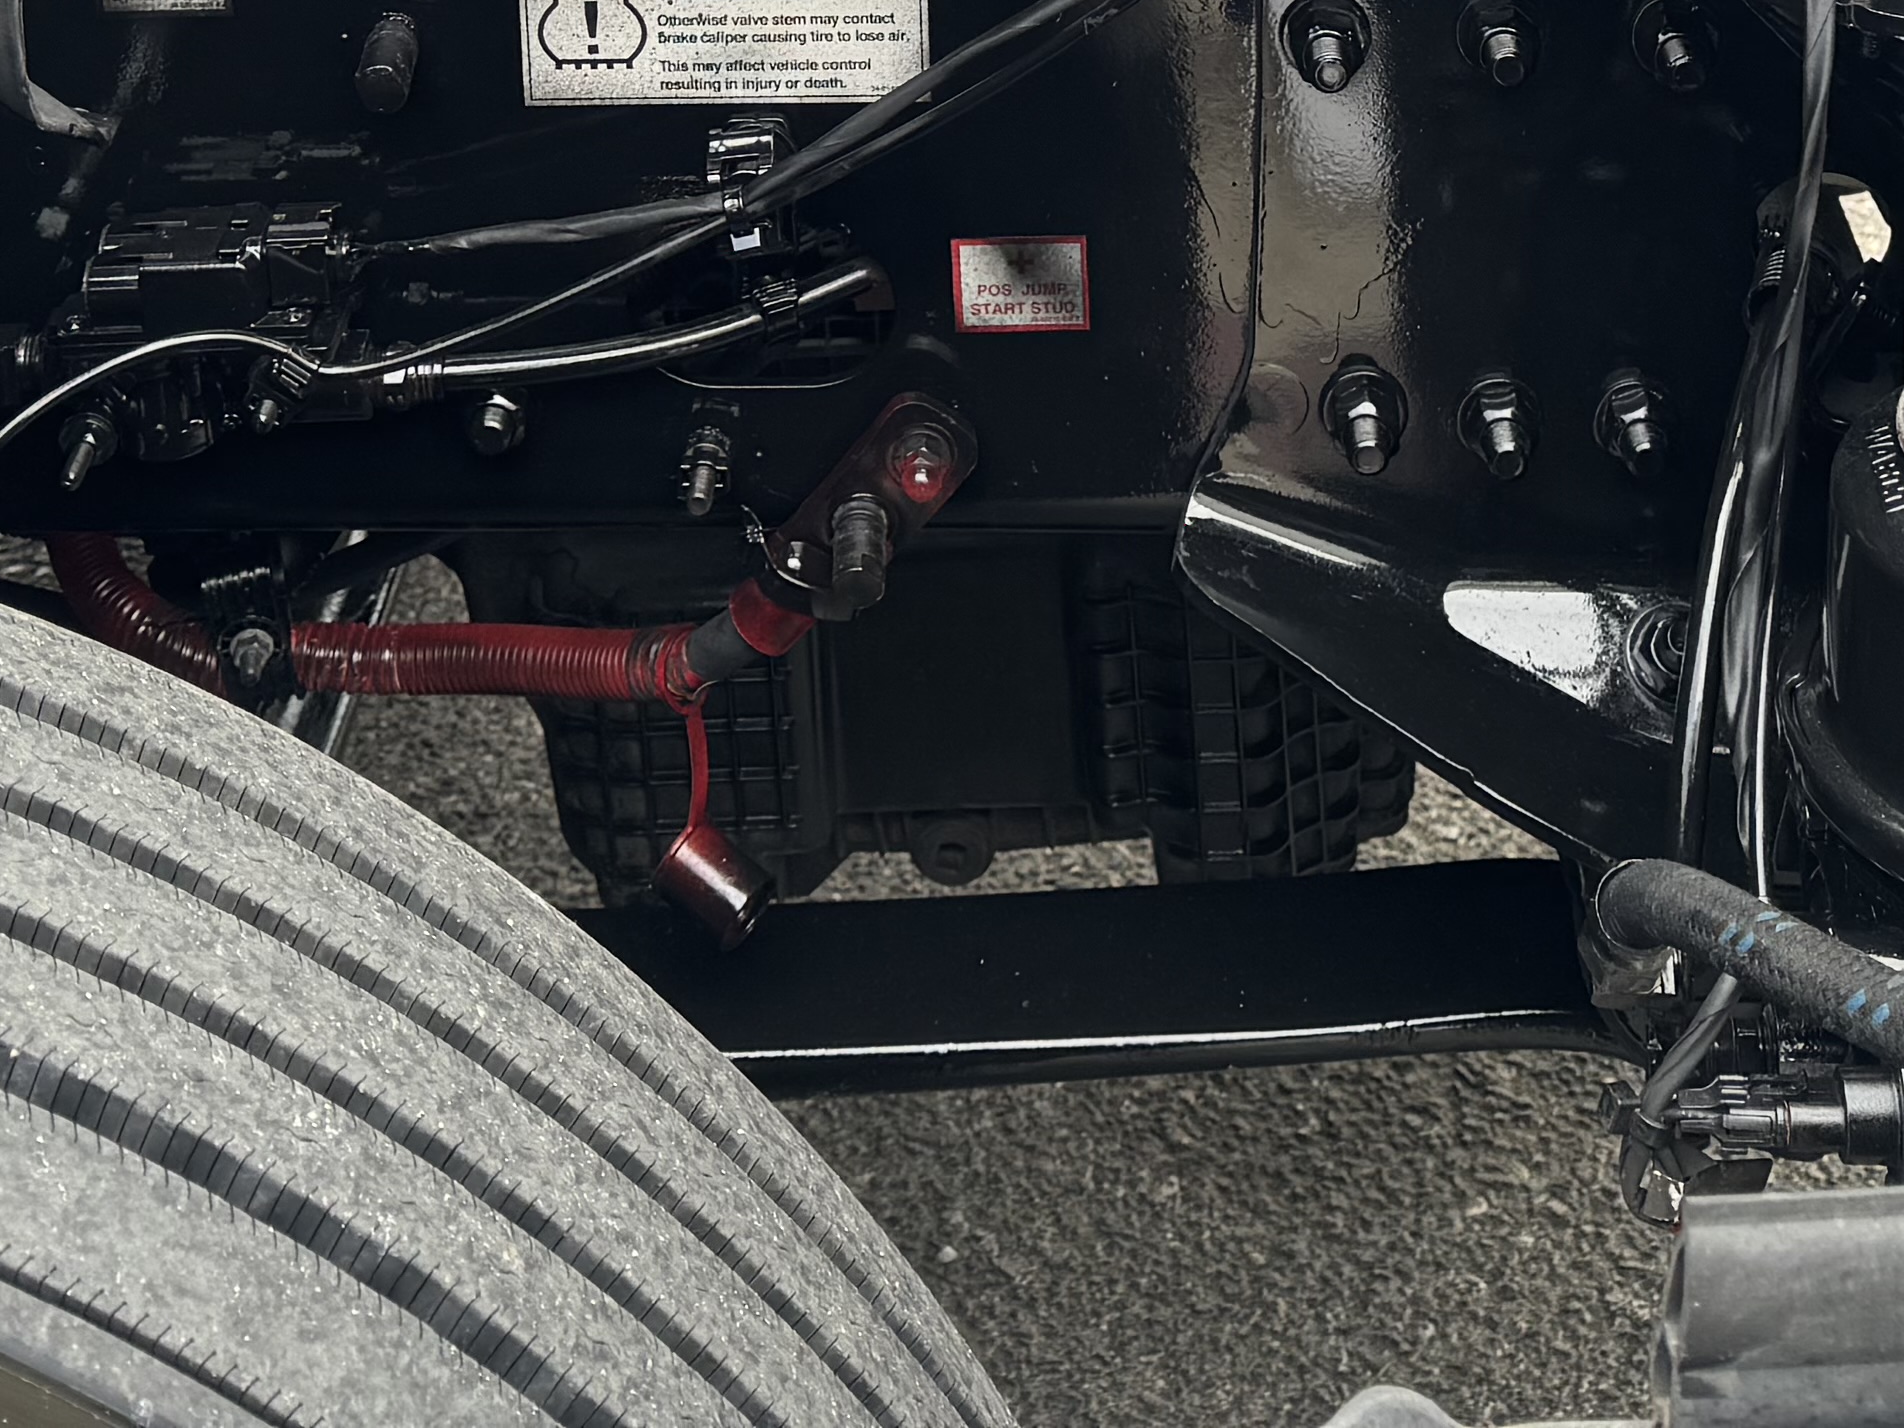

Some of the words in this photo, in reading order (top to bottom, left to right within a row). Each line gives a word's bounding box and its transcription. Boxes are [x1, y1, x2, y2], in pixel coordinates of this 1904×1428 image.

[657, 13, 729, 28] Otherwise
[731, 13, 769, 27] valve
[771, 14, 807, 27] stem
[809, 14, 839, 29] may
[842, 12, 896, 26] contact
[657, 30, 698, 44] brake
[699, 30, 748, 47] caliper
[751, 30, 807, 46] causing
[809, 29, 834, 43] tire
[836, 30, 852, 43] to
[855, 28, 885, 42] lose
[658, 59, 689, 73] This
[692, 61, 723, 75] may
[725, 59, 766, 73] affect
[768, 58, 819, 72] vehicle
[821, 57, 872, 72] control
[659, 75, 722, 93] resulting
[724, 76, 739, 90] in
[742, 76, 782, 93] injury
[784, 78, 802, 90] or
[803, 76, 848, 90] death.
[977, 283, 1014, 298] POS
[1020, 282, 1069, 297] JUMP
[969, 301, 1027, 317] START
[1030, 300, 1077, 315] STUD
